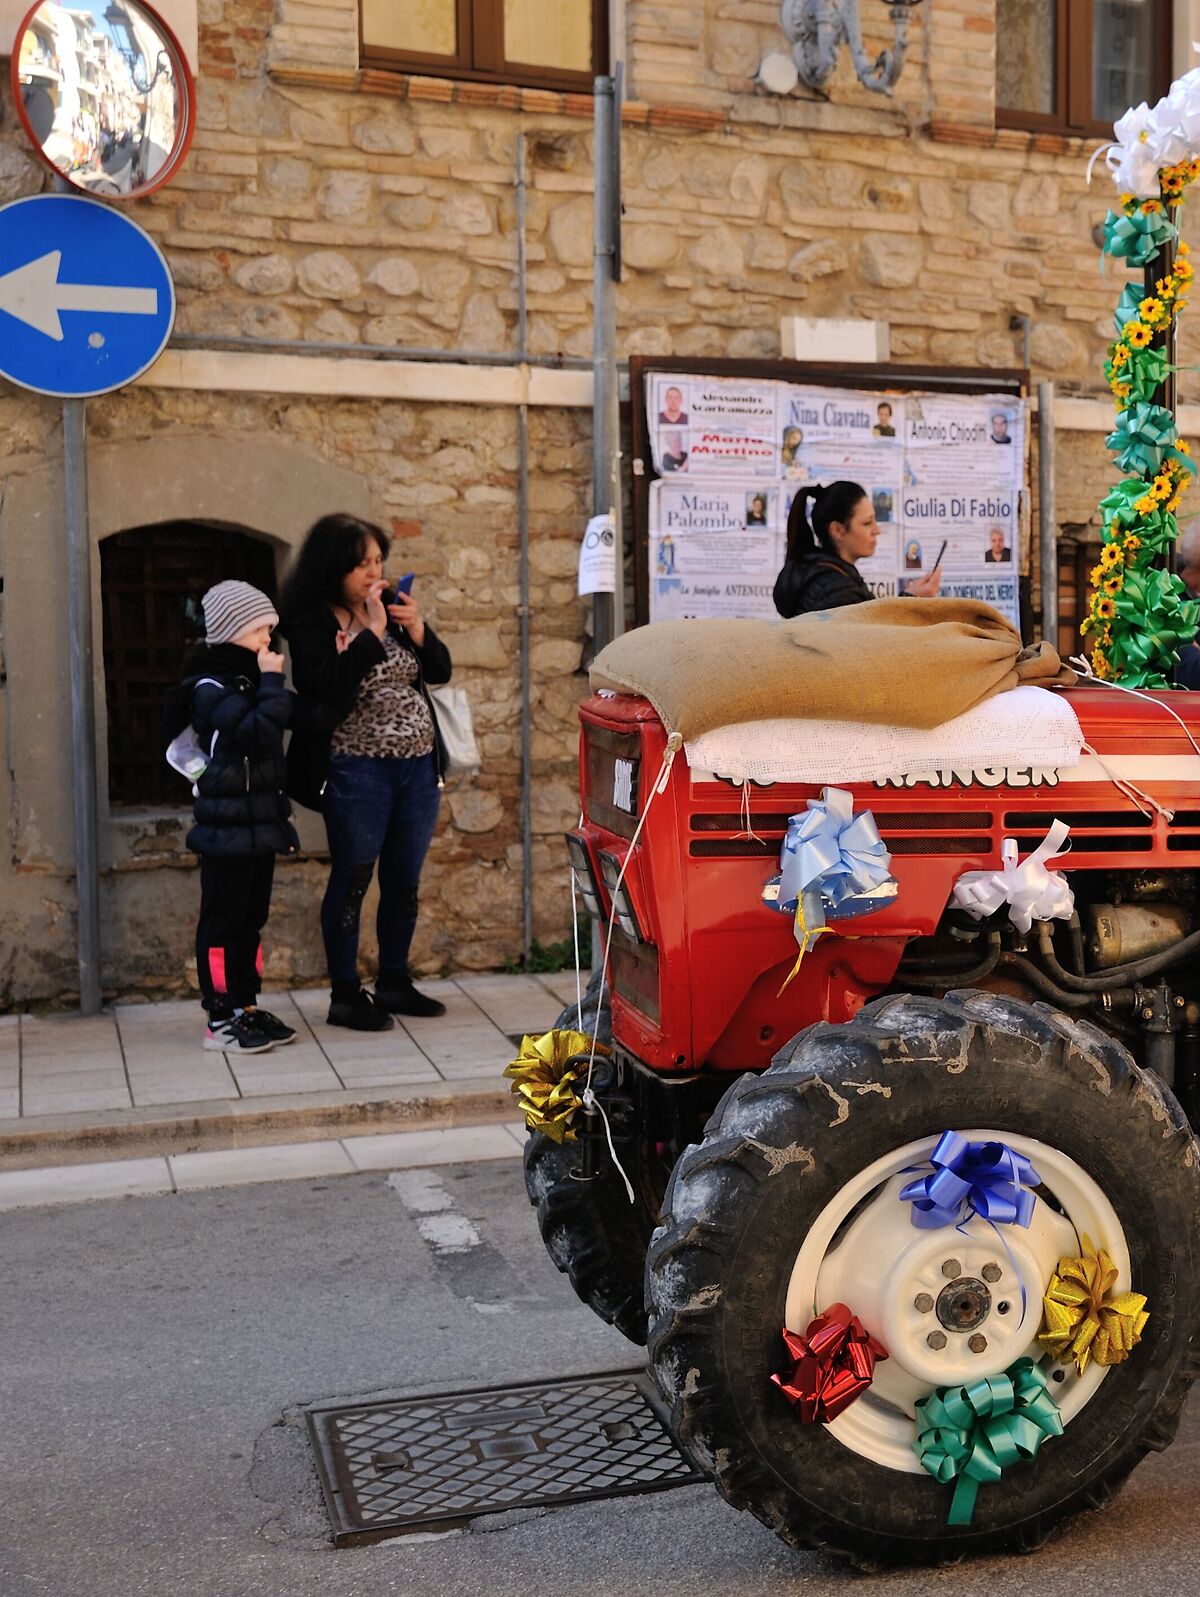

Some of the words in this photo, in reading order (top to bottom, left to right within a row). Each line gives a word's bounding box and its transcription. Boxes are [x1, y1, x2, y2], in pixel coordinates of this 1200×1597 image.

[790, 399, 819, 425] Nina
[823, 402, 871, 428] Ciavatta
[911, 421, 947, 441] Antonio
[681, 494, 729, 511] Maria
[904, 497, 946, 517] Giulia
[951, 498, 965, 517] Di
[971, 497, 1011, 517] Fabio
[667, 511, 742, 528] Palombo
